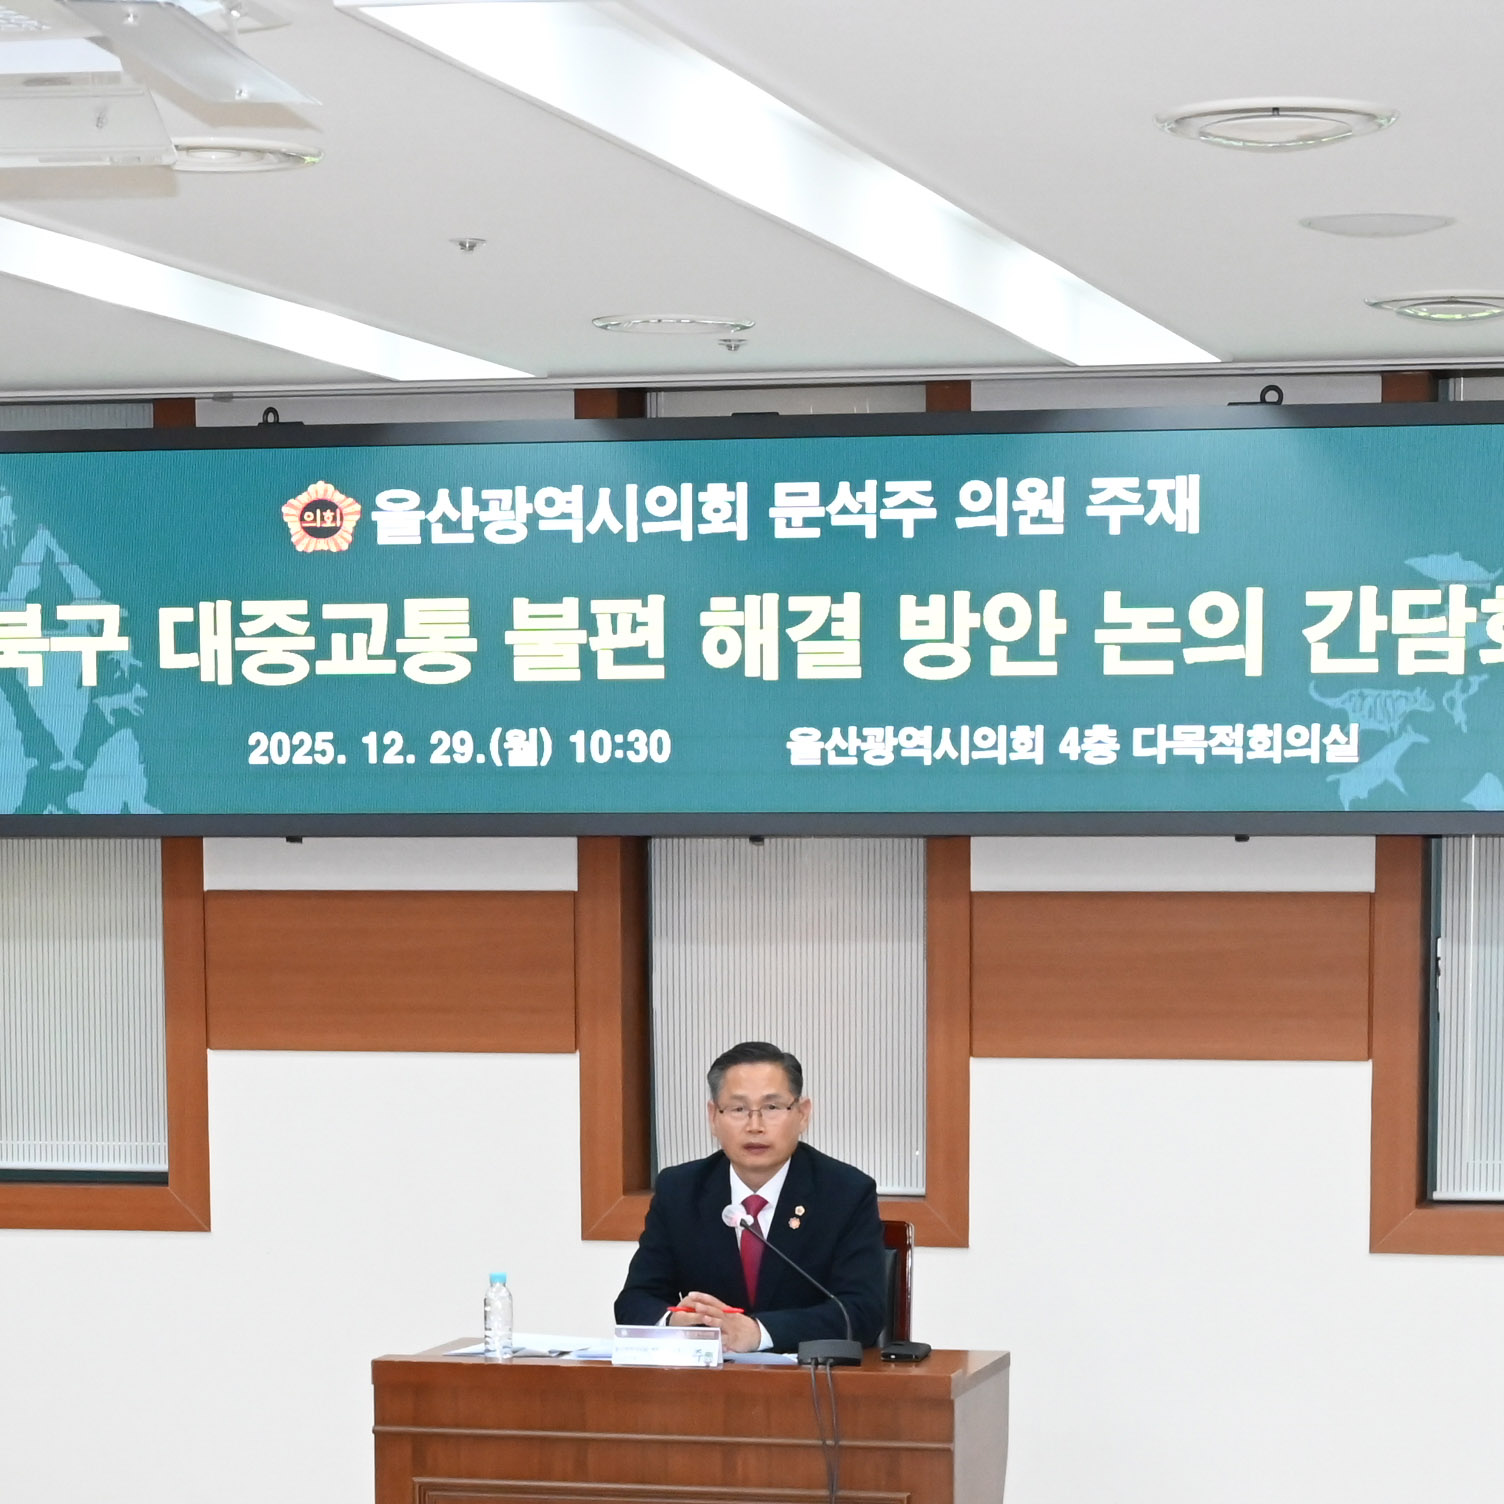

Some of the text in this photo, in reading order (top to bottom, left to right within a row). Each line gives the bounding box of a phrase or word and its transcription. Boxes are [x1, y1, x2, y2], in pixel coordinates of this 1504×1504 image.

[301, 508, 342, 528] 의회
[372, 474, 1201, 545] 울산광역시의회 문석주 의원 주재
[158, 598, 478, 686] 대중교통
[504, 595, 666, 682] 불편
[699, 590, 862, 681] 해결
[899, 590, 1067, 681] 방안
[1094, 587, 1264, 677] 논의
[248, 728, 671, 767] 2025. 12. 29.(월) 10:30
[786, 723, 1359, 766] 울산광역시의회 4층 다목적회의실
